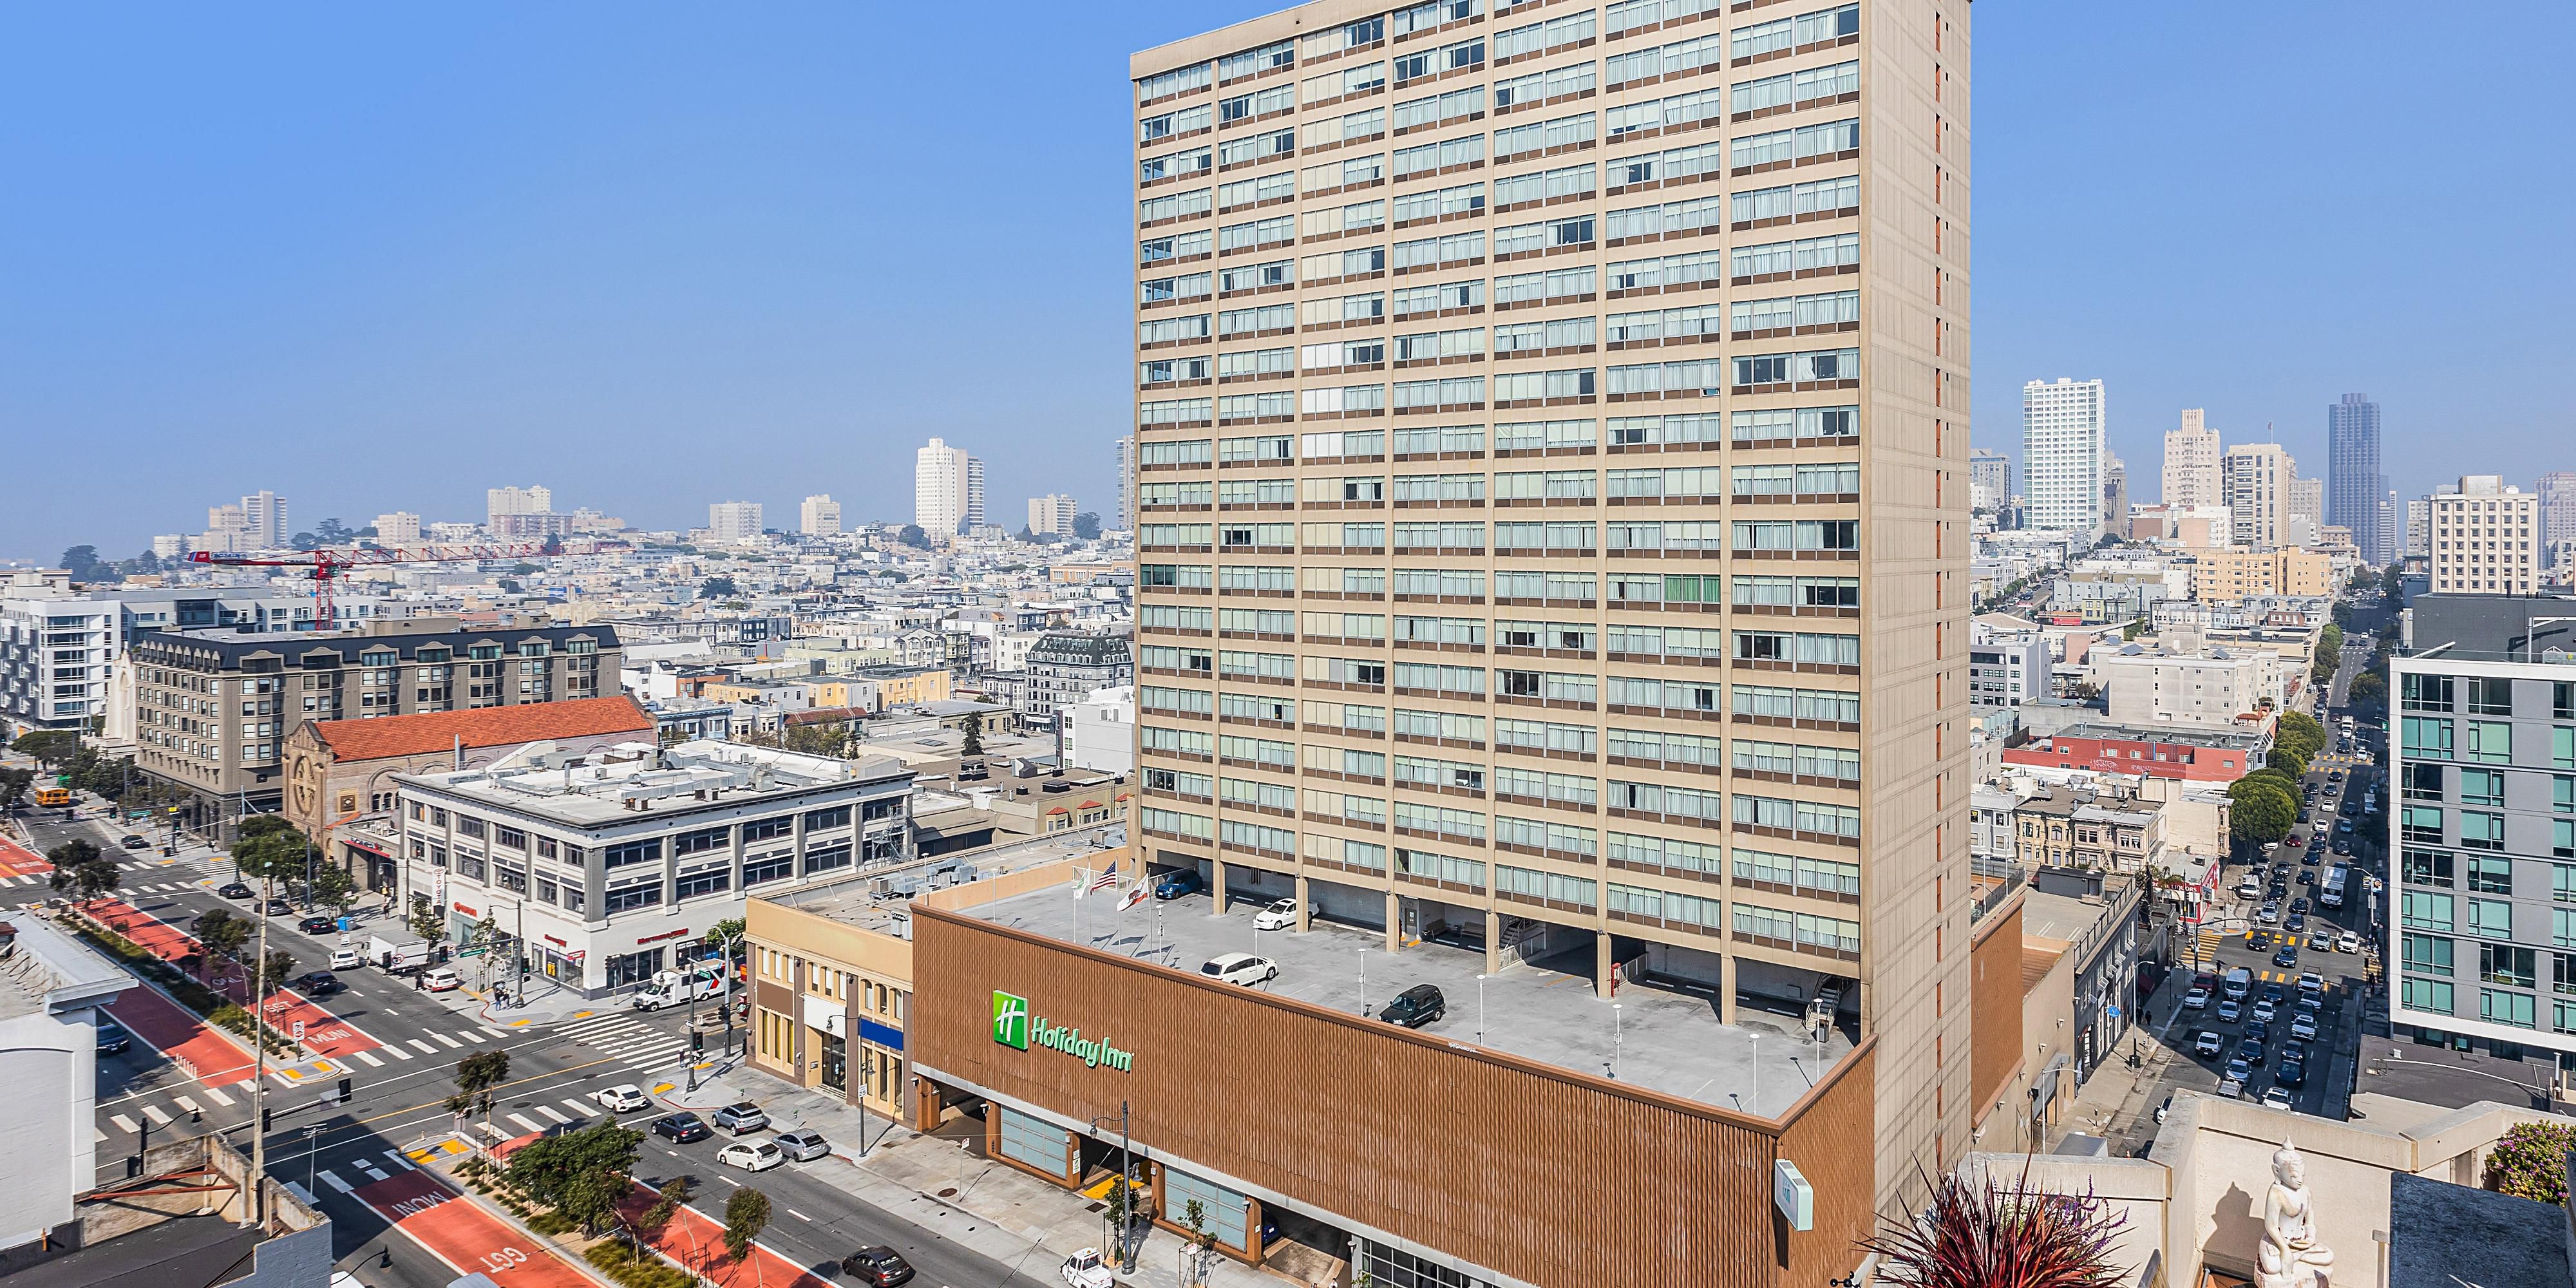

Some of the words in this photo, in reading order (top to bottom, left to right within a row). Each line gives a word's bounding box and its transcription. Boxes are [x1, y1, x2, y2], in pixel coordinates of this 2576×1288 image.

[307, 1028, 353, 1044] MUNI
[1030, 1016, 1101, 1066] Holiday
[1101, 1037, 1132, 1072] Inn
[392, 1191, 451, 1218] MUNI
[478, 1247, 527, 1274] GGT
